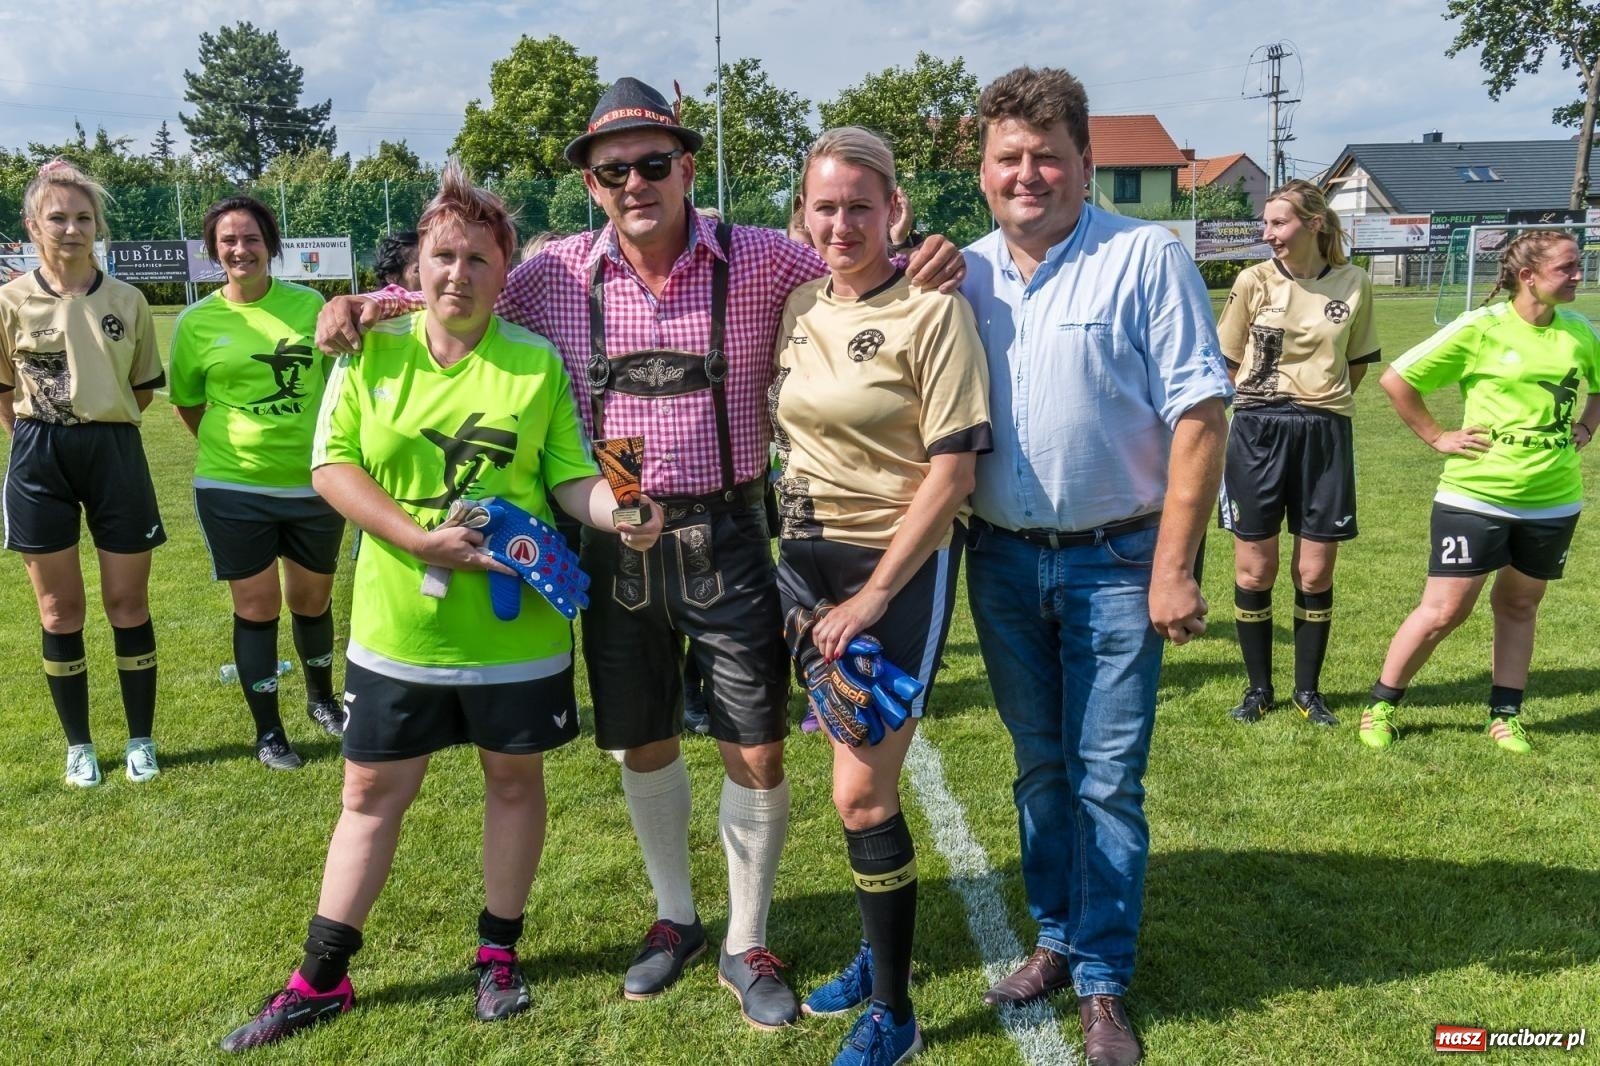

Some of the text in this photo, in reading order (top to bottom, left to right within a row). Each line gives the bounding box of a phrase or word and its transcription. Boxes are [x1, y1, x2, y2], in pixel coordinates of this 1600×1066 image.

[611, 107, 642, 120] BERG
[296, 241, 347, 249] KRZYŻANOWICE
[111, 249, 185, 264] JUBILER
[1441, 536, 1472, 564] 21
[830, 670, 867, 705] reusch
[859, 870, 911, 888] EFCE
